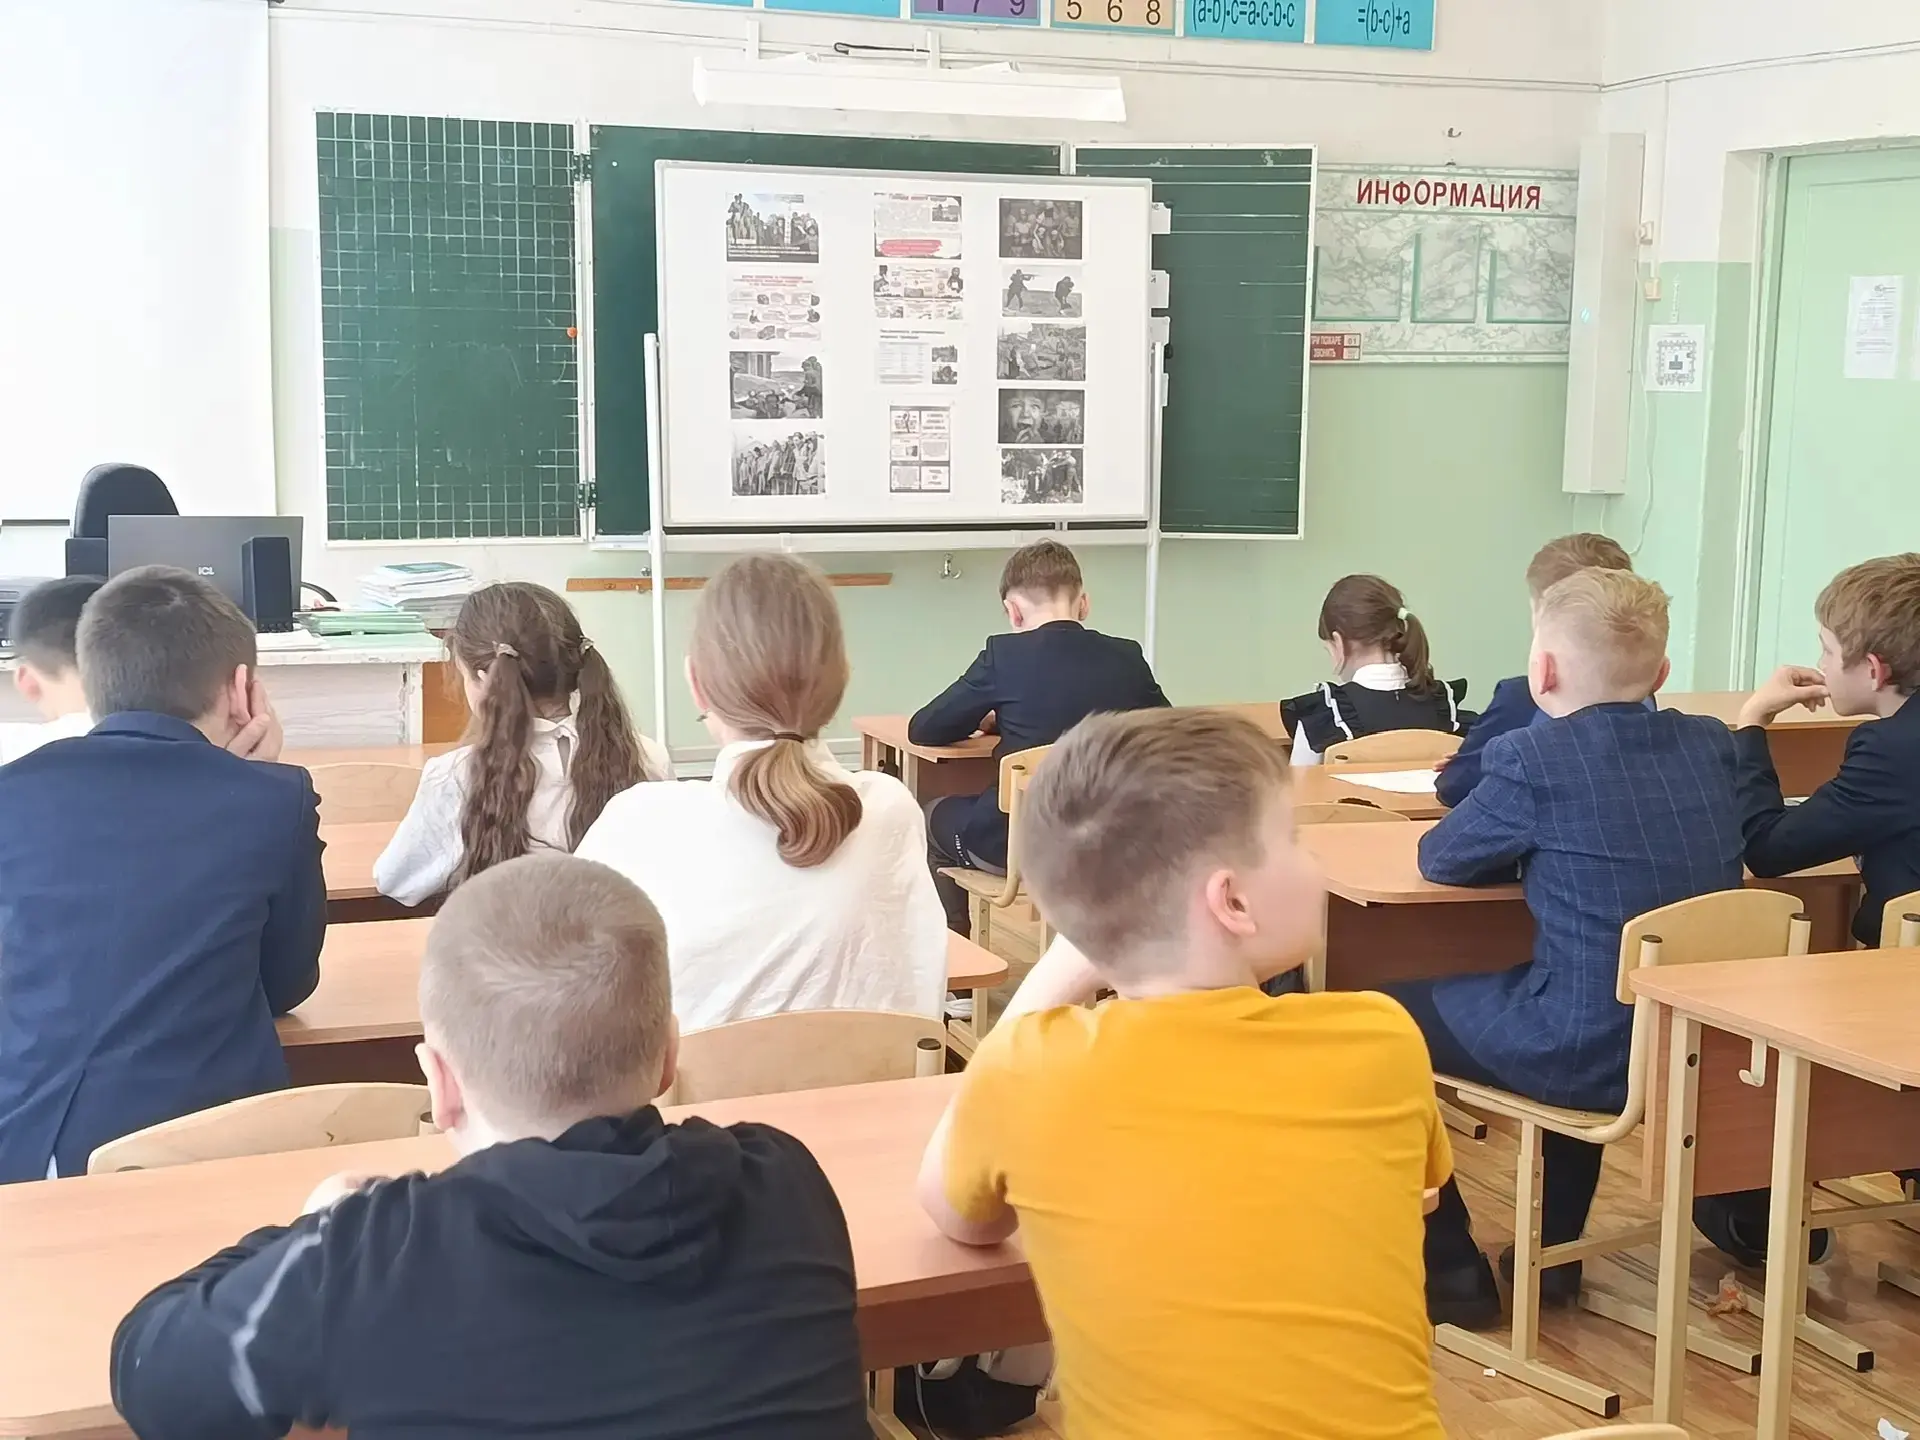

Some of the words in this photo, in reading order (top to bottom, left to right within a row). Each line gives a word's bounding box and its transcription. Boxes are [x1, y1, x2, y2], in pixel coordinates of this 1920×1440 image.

[1066, 0, 1082, 20] 5
[1107, 0, 1123, 23] 6
[1146, 0, 1161, 25] 8
[1357, 178, 1541, 212] ИНФОРМАЦИЯ
[198, 566, 215, 576] ICL
